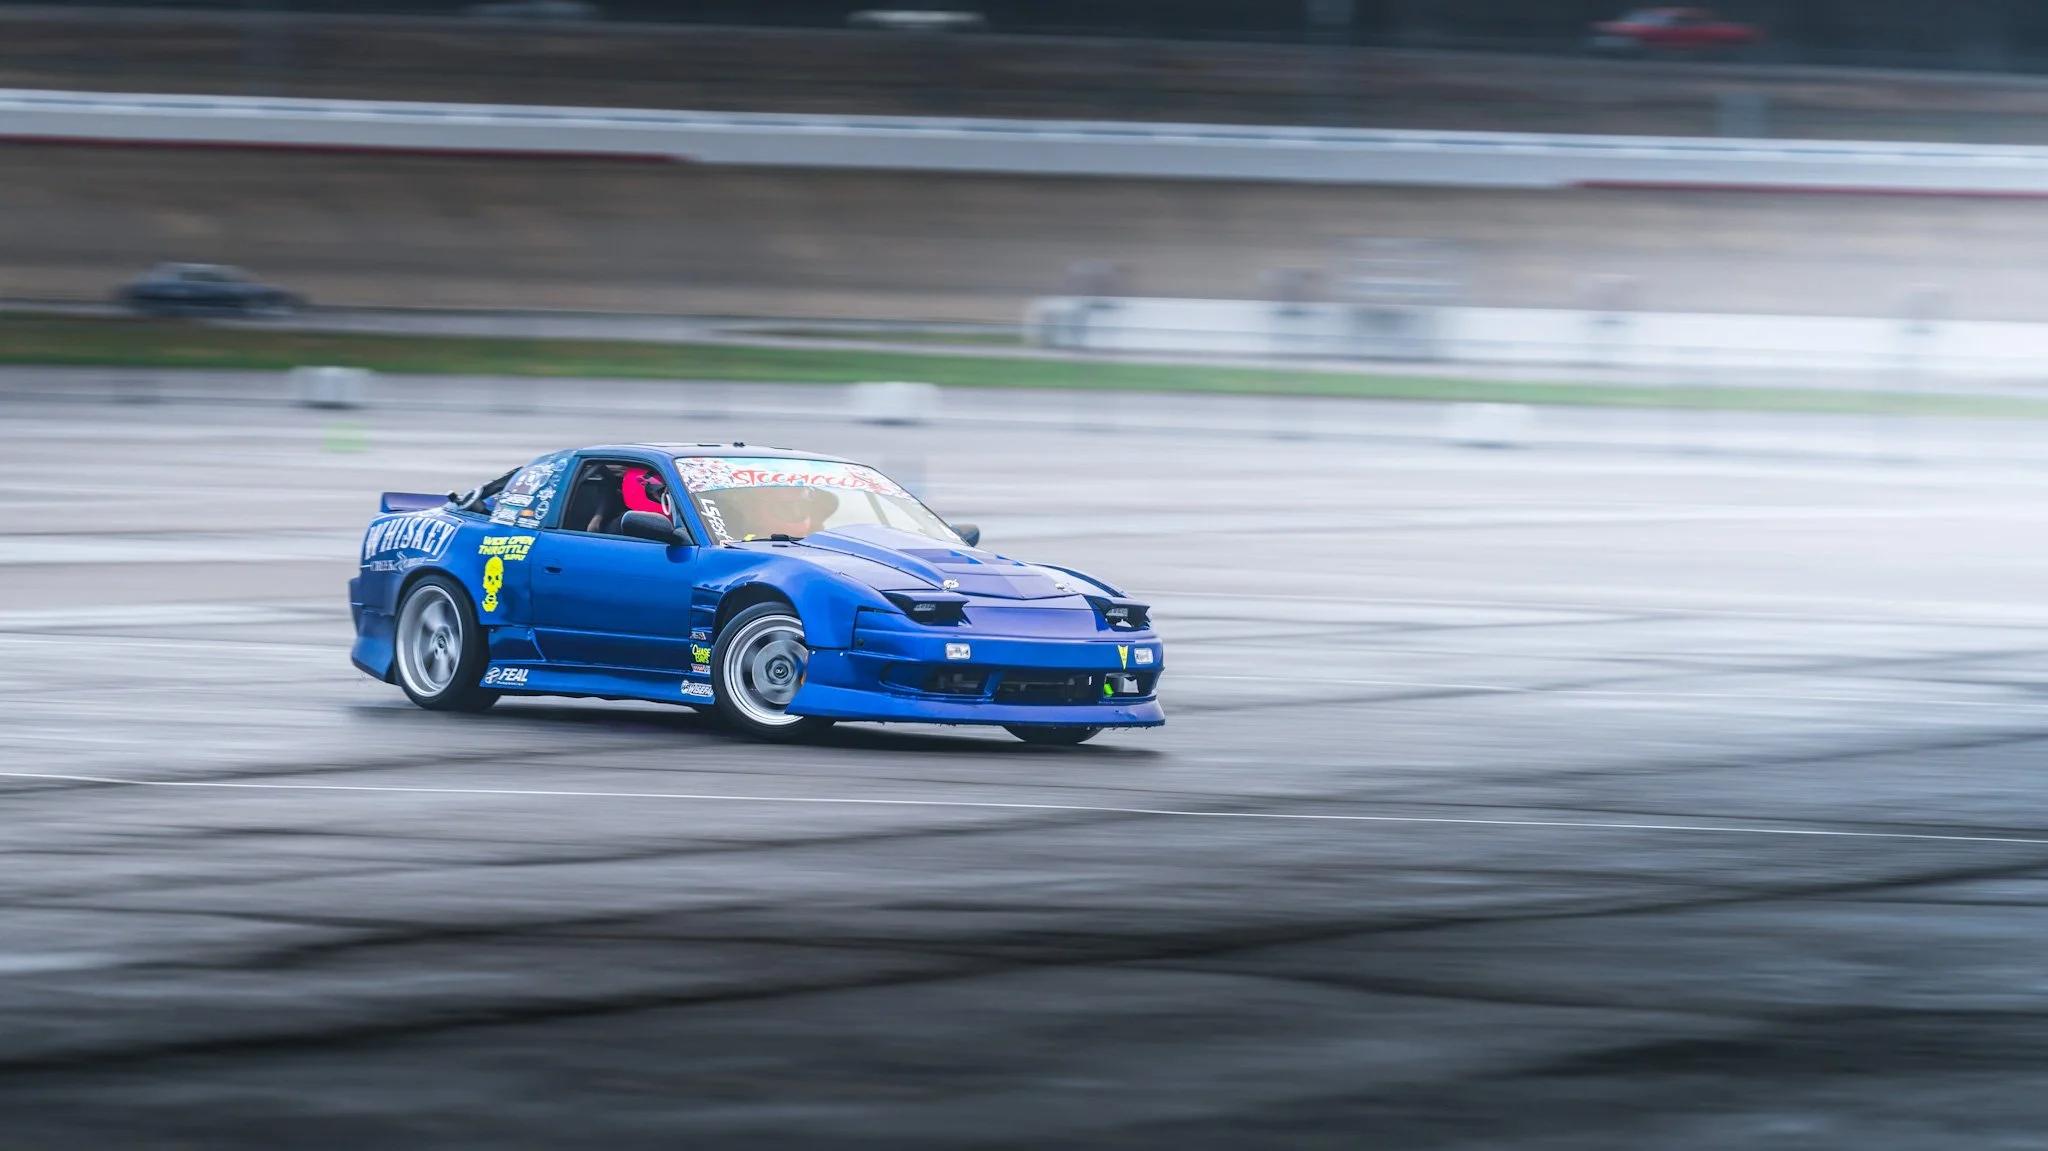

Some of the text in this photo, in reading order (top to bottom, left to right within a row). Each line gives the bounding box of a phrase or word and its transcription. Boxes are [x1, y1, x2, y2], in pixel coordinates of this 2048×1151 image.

[366, 516, 455, 559] WHISKEY
[478, 545, 529, 555] THROTTLE
[498, 667, 529, 682] FEAL
